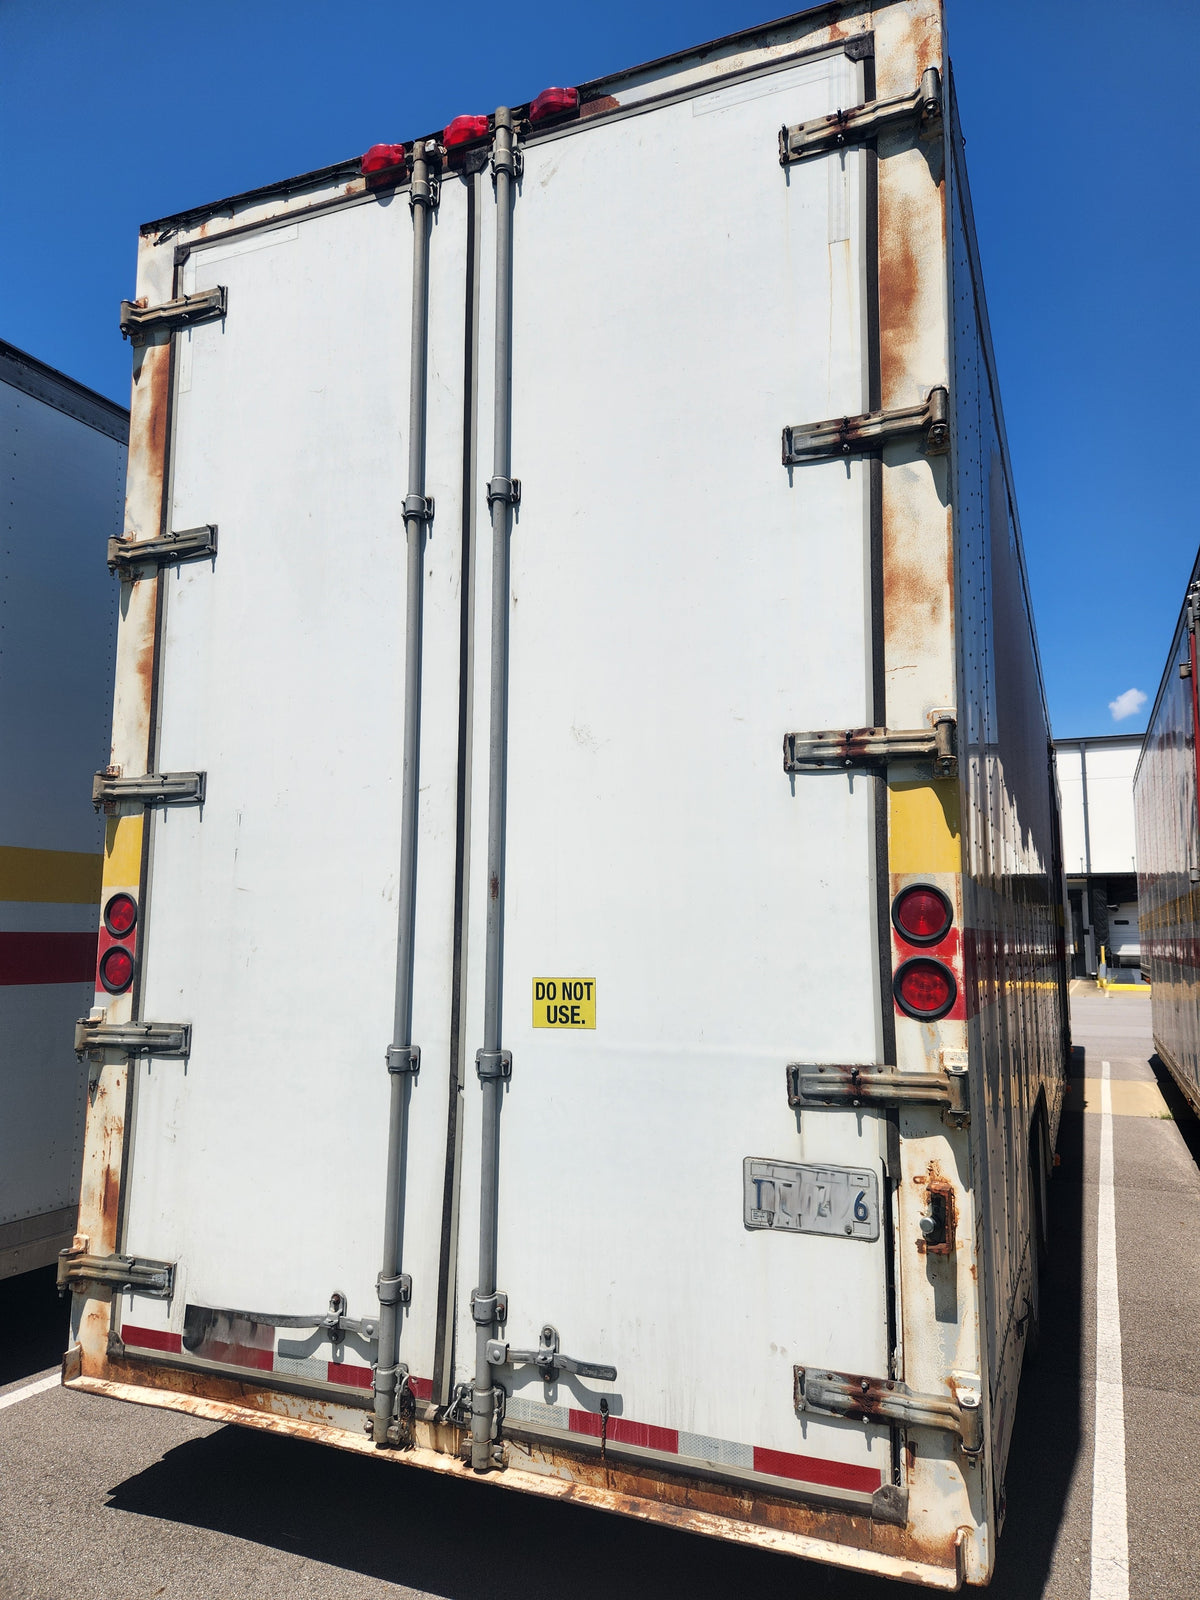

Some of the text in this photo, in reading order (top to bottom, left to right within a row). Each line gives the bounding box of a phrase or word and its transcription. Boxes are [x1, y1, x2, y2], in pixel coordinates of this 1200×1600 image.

[535, 982, 594, 1001] DO NOT
[546, 1005, 586, 1024] USE.
